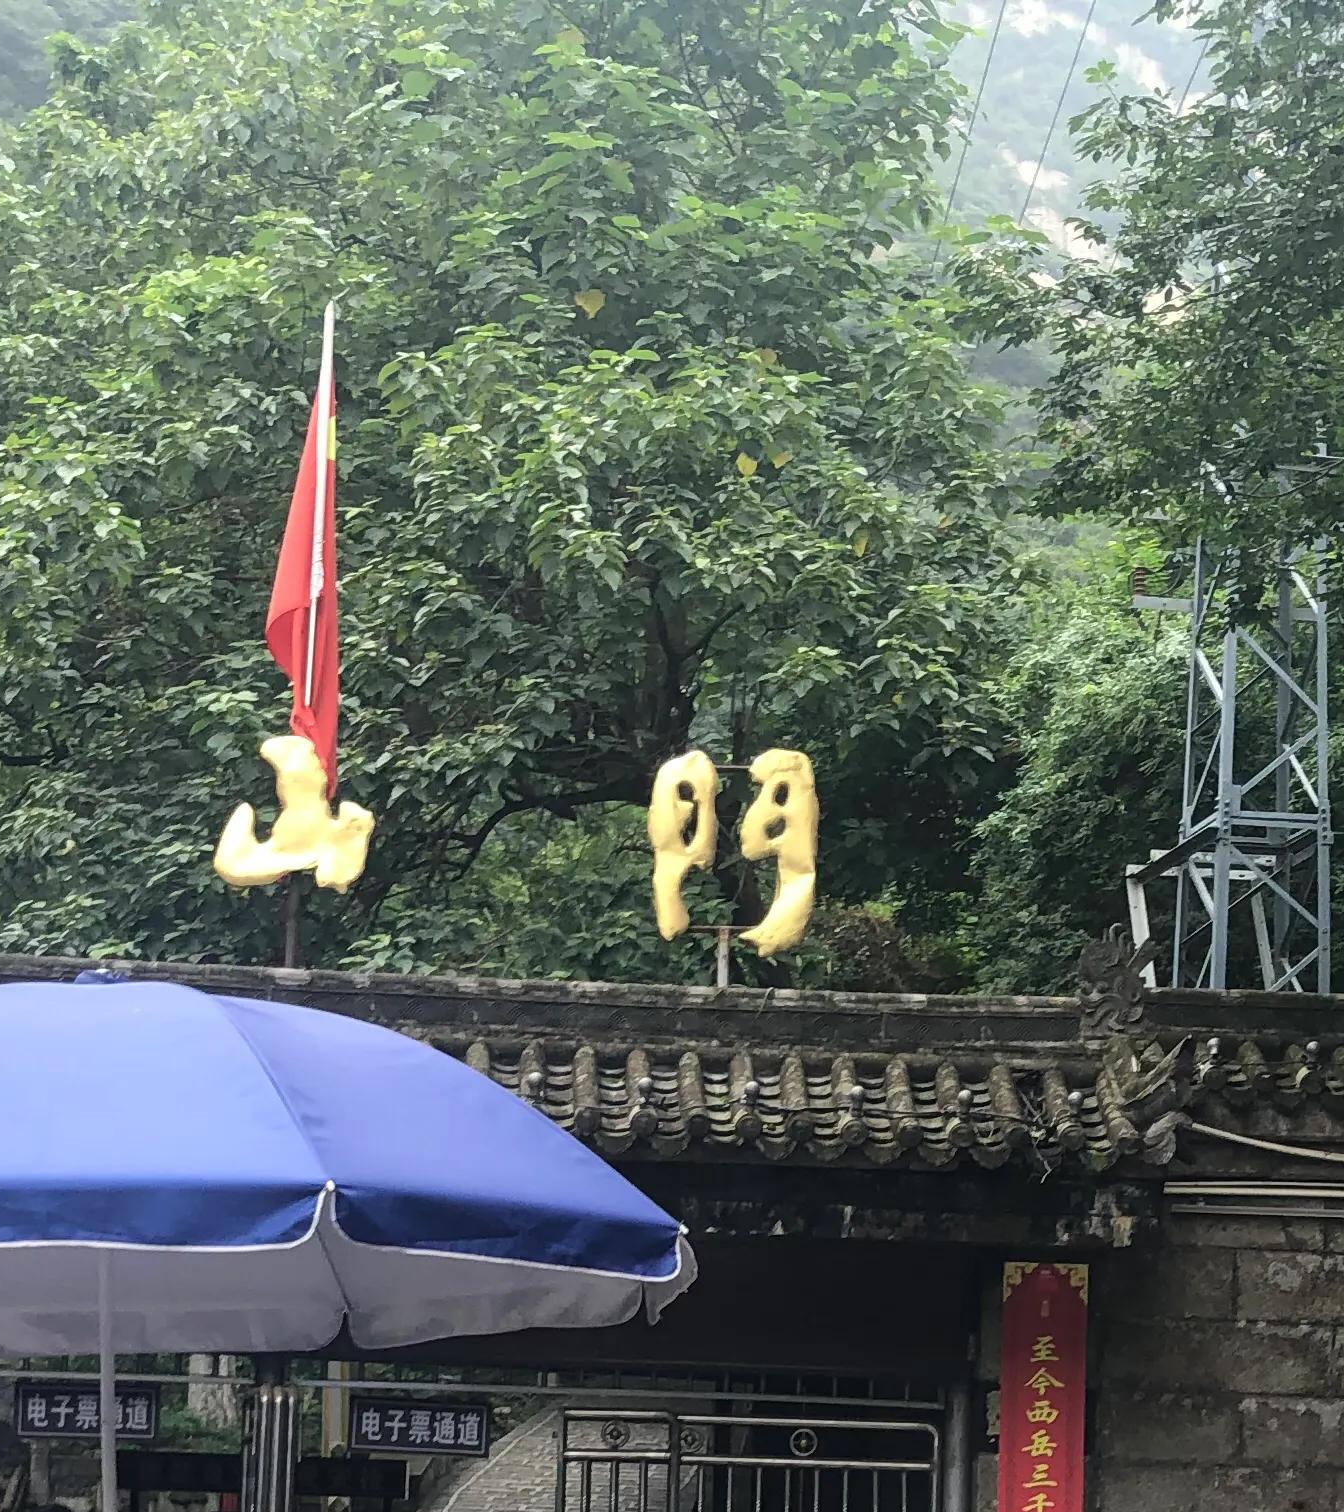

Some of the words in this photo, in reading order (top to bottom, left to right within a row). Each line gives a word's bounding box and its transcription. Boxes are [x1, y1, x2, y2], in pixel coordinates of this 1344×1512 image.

[361, 1407, 481, 1446] 电子票通道
